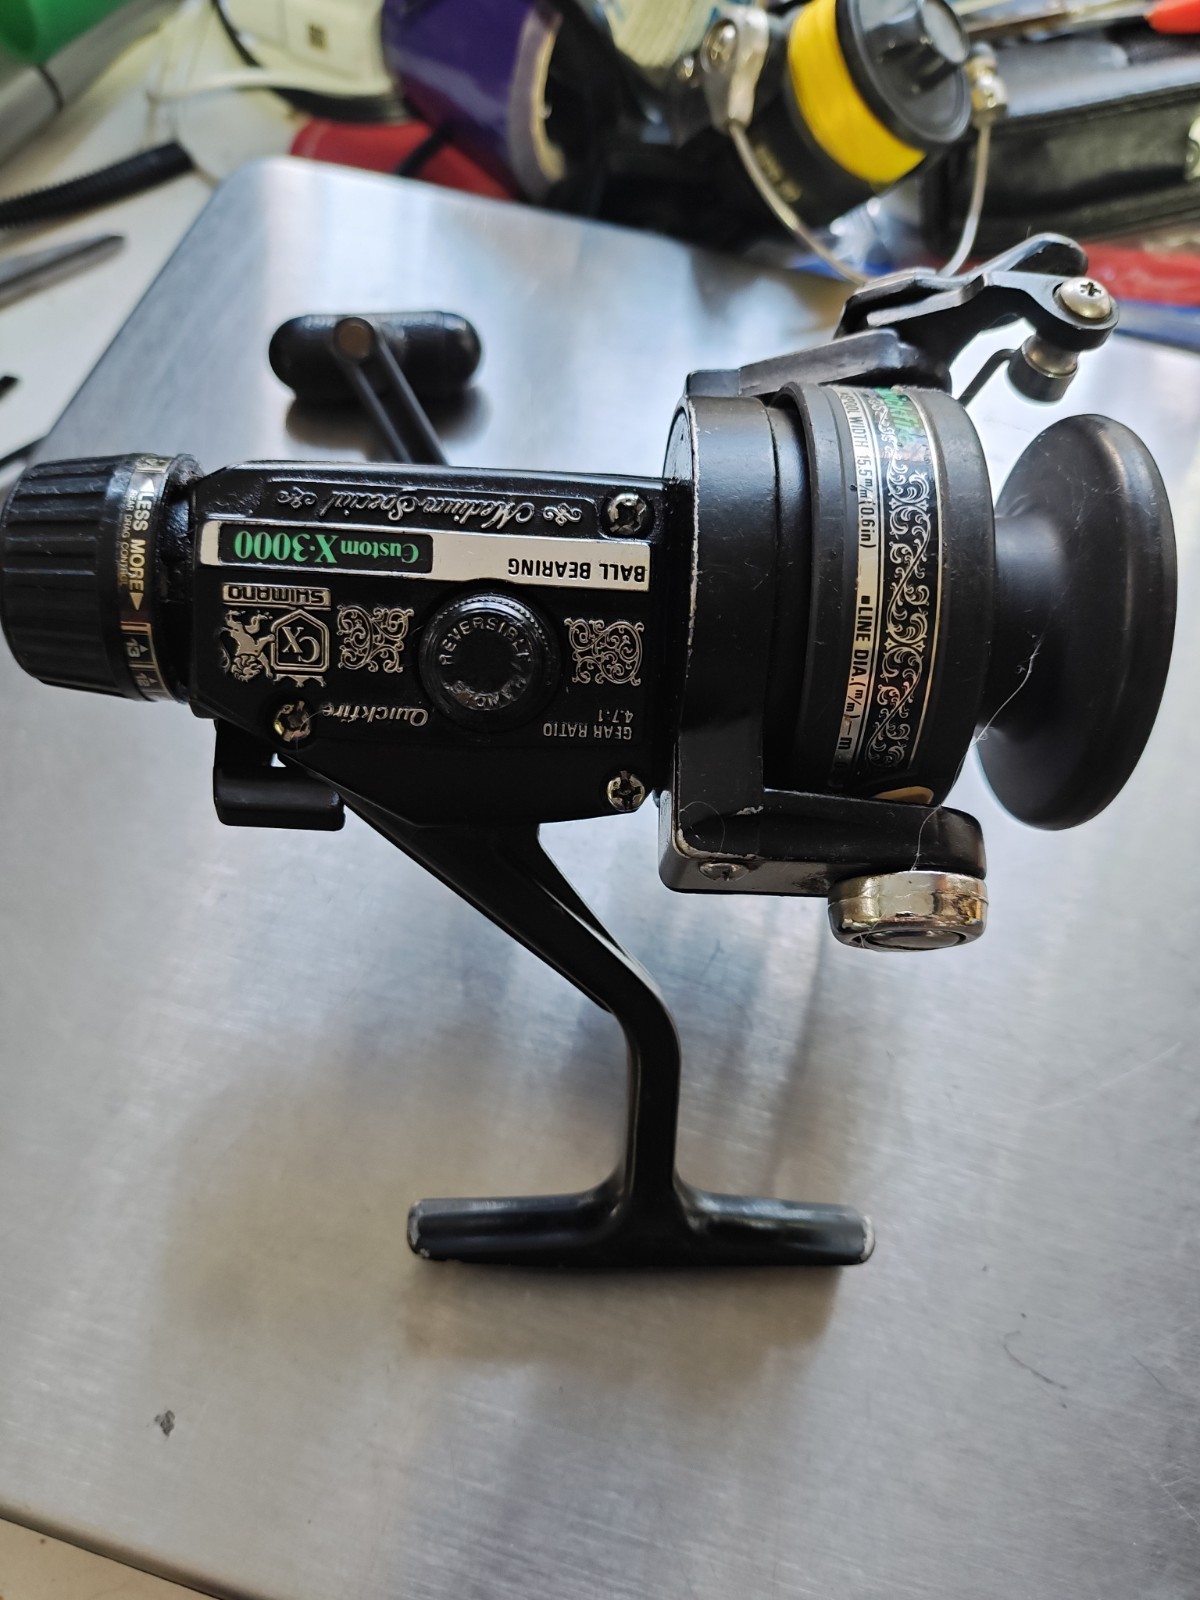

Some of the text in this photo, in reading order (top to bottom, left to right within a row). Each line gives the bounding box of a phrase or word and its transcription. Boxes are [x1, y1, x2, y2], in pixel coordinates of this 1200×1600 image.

[849, 417, 869, 448] WIDTH
[326, 491, 535, 531] Medium Special
[121, 515, 133, 538] DRAG
[129, 493, 154, 591] LESS MORE
[340, 539, 419, 564] Custom
[507, 558, 646, 583] BALL BEARING
[226, 584, 325, 605] SHIMANO
[855, 607, 874, 642] LINE
[282, 625, 320, 661] CX
[321, 704, 429, 727] Quickfire
[597, 709, 634, 724] 4.7:1
[542, 723, 633, 740] GEAR RATIO
